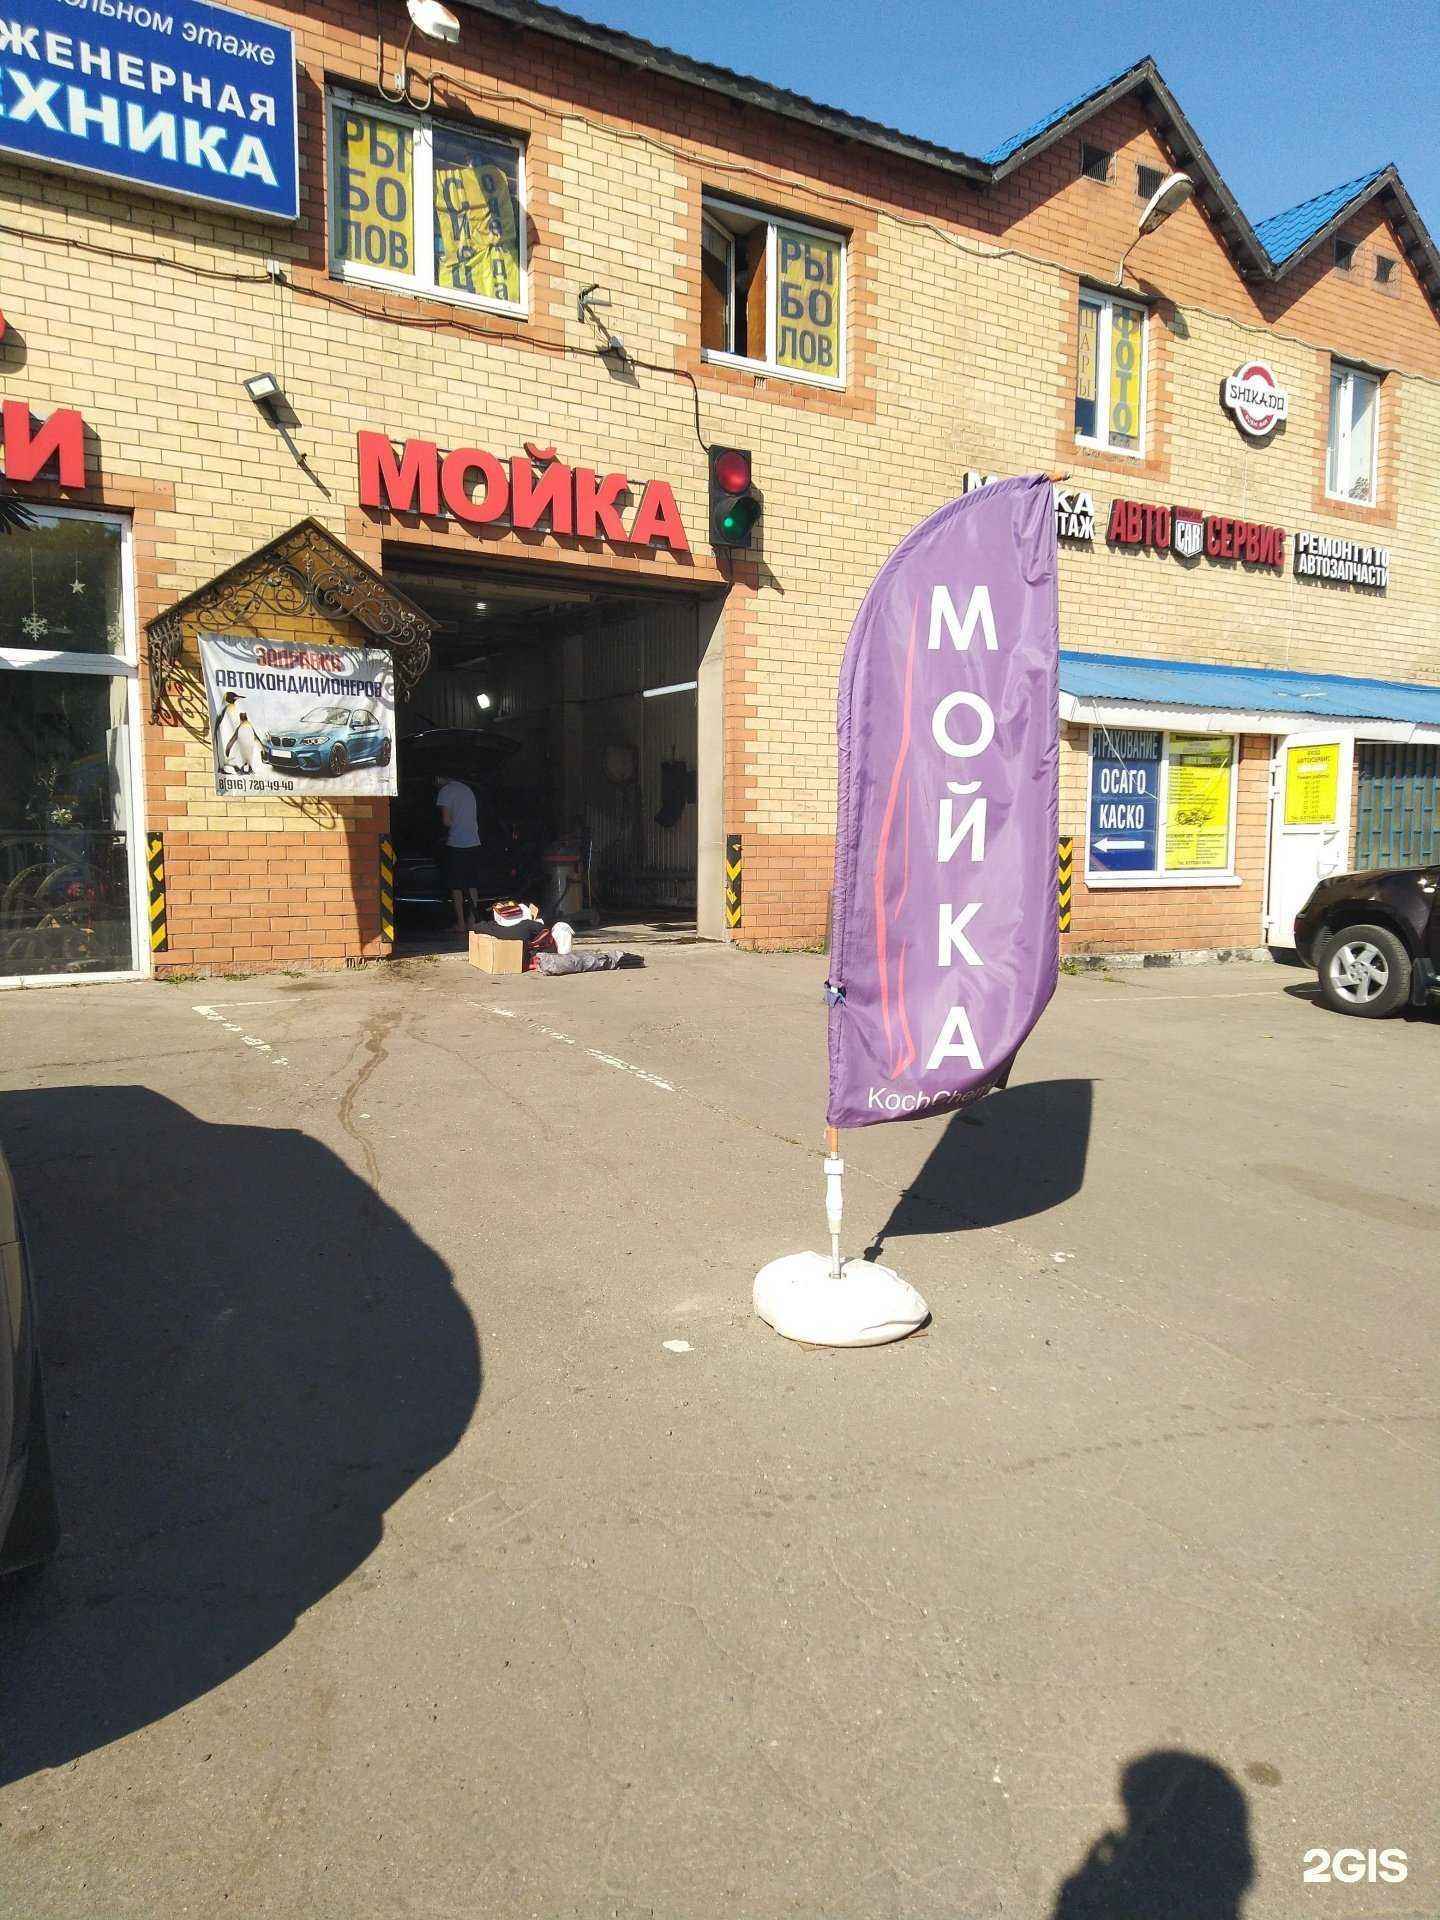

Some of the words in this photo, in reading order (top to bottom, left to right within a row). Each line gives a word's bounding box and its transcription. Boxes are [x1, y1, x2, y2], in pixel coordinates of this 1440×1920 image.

[182, 21, 276, 66] этаже
[0, 17, 276, 126] ЖЕНЕРНАЯ
[0, 65, 280, 187] ХНИКА
[782, 240, 833, 285] РЫ
[781, 280, 833, 327] БО
[779, 326, 833, 367] ЛОВ
[1230, 384, 1284, 411] SHIKADO
[357, 430, 690, 551] МОЙКА
[1055, 511, 1096, 540] ТАЖ
[1109, 499, 1171, 549] АВТО
[1177, 521, 1202, 555] CAR
[1206, 514, 1287, 567] СЕРВИС
[1299, 532, 1359, 562] РЕМОНТ
[1298, 553, 1389, 587] АВТОЗАПЧАСТИ
[215, 669, 382, 698] АВТОКОНДИЦИОНЕРОВ
[1093, 729, 1158, 760] СТРАХОВАНИЕ
[218, 778, 246, 791] 8(916)
[1101, 767, 1147, 794] ОСАГО
[926, 584, 999, 1071] МОЙКА
[1100, 803, 1145, 830] КАСКО
